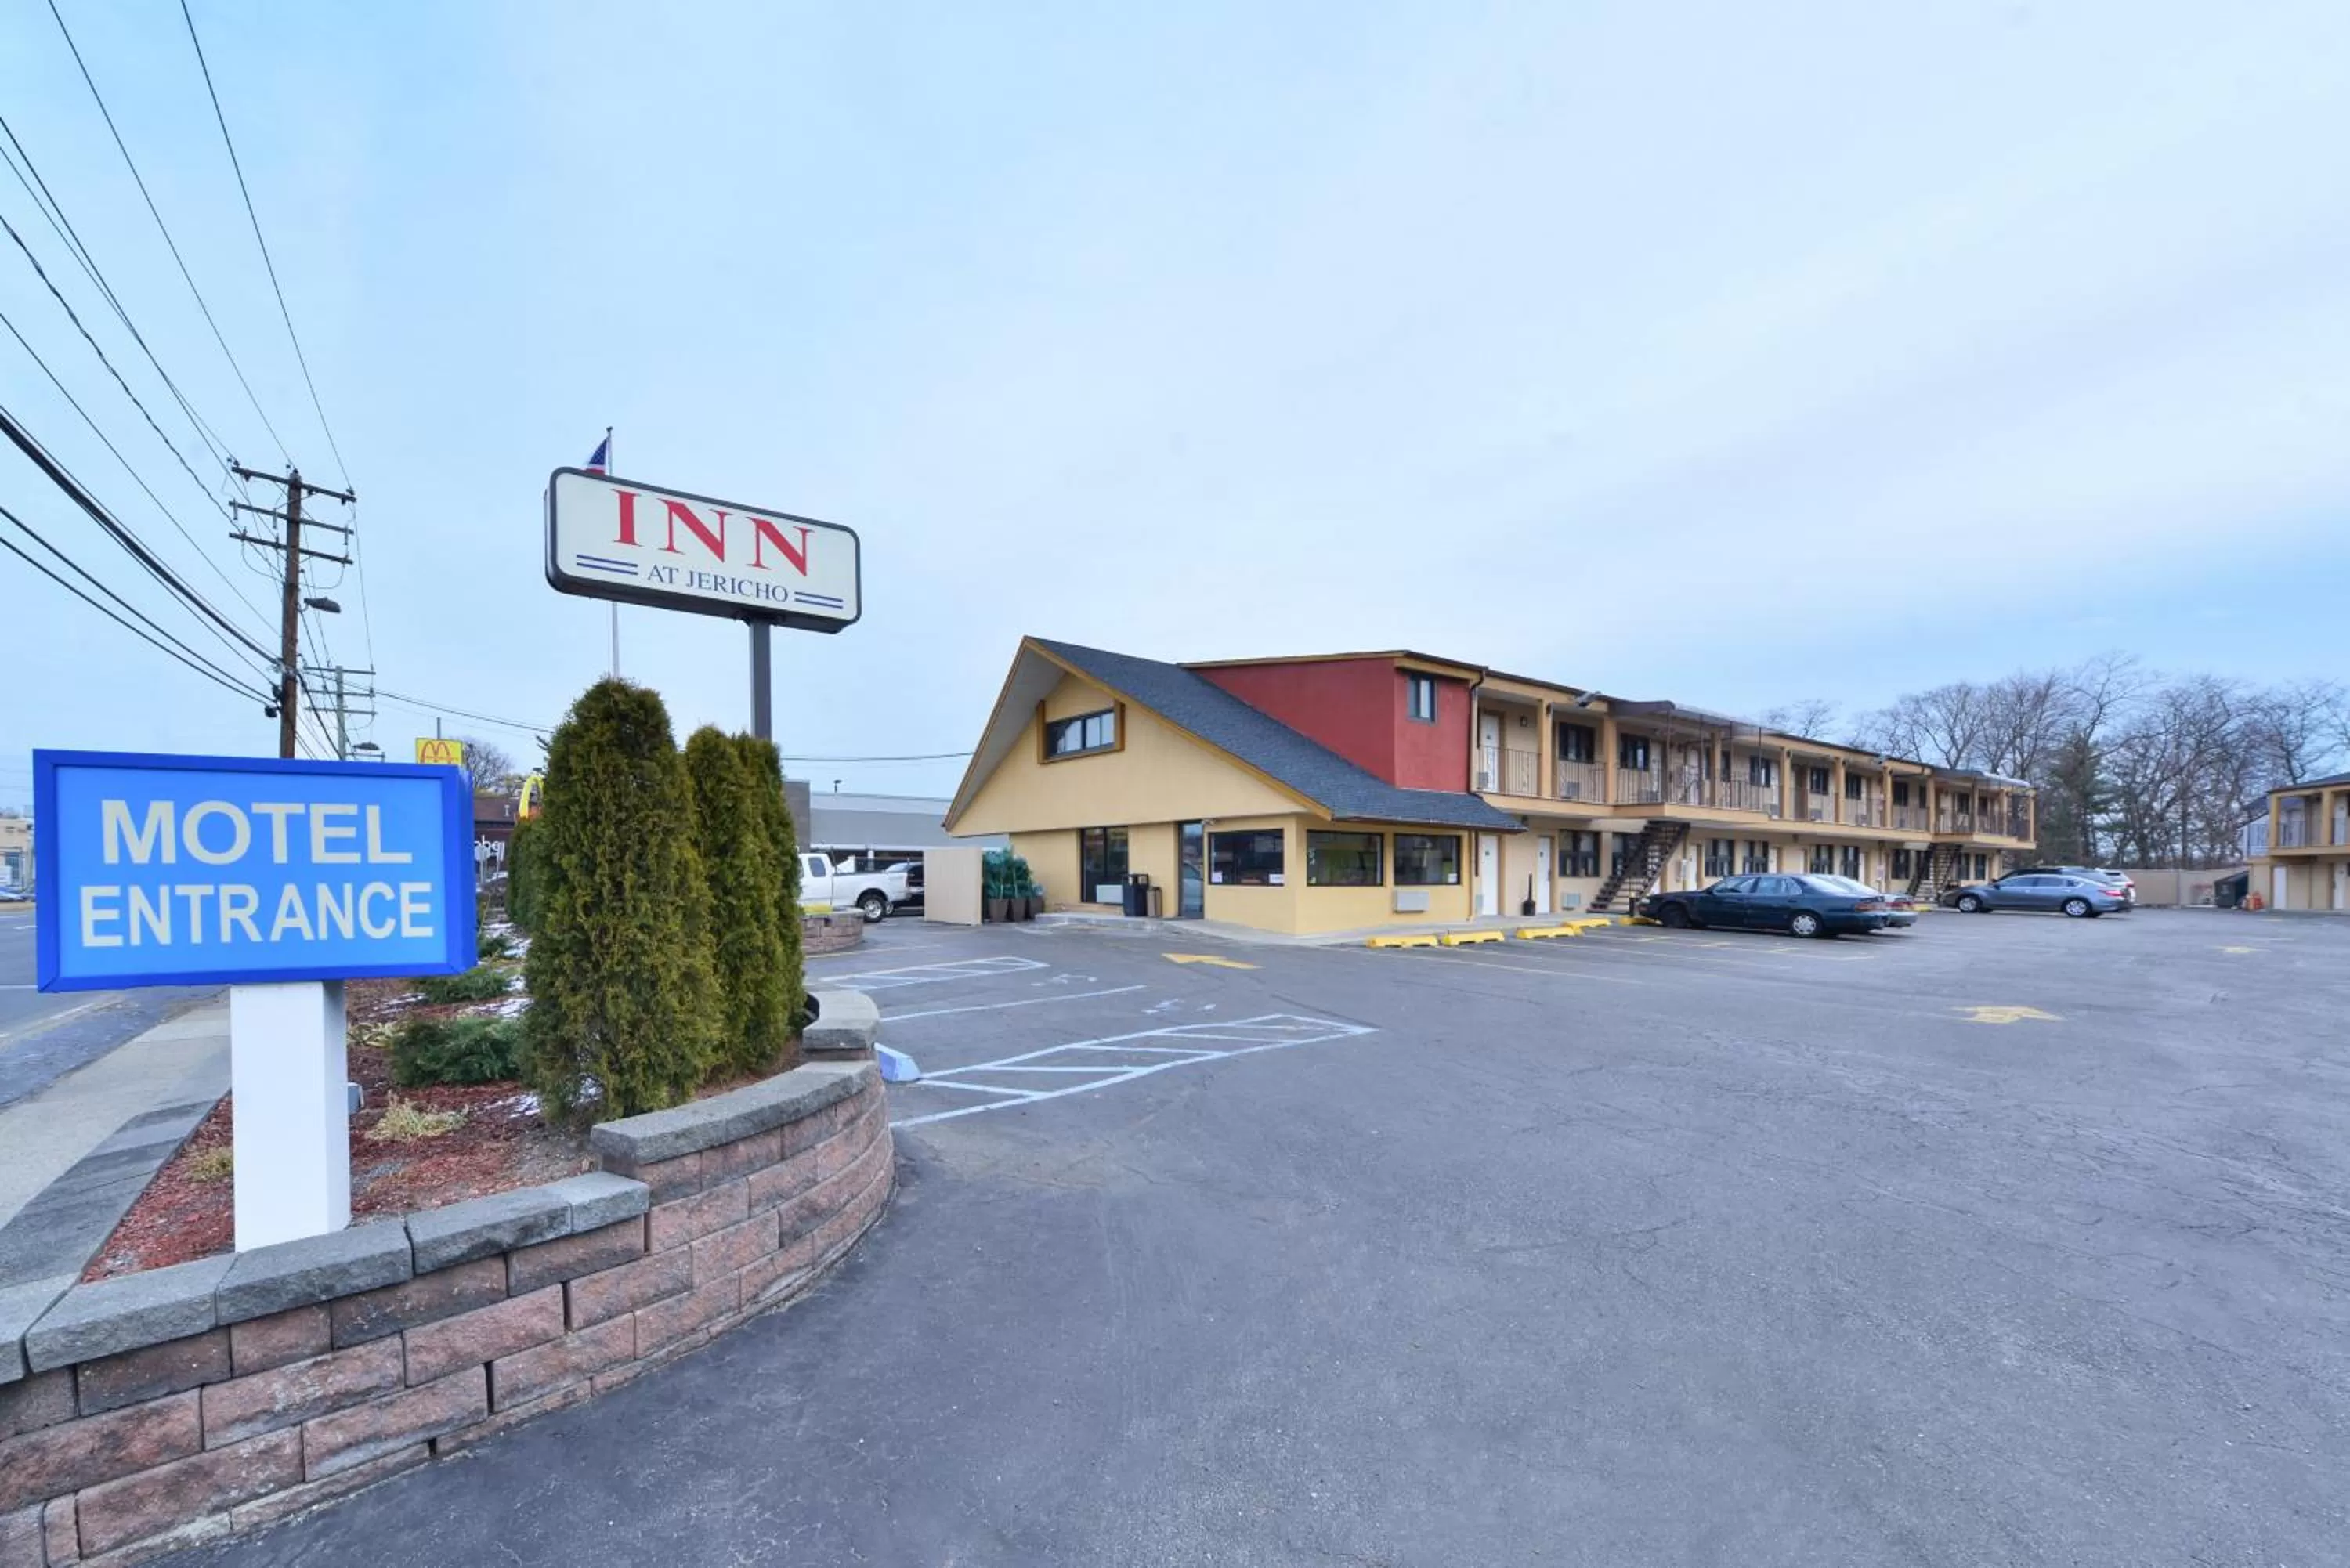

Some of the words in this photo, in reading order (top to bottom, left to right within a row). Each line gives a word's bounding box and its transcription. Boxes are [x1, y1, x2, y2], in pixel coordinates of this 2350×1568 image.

[612, 488, 815, 577] INN
[647, 563, 679, 584] AT
[685, 569, 790, 603] JERICHO
[101, 799, 414, 865] MOTEL
[81, 882, 434, 948] ENTRANCE
